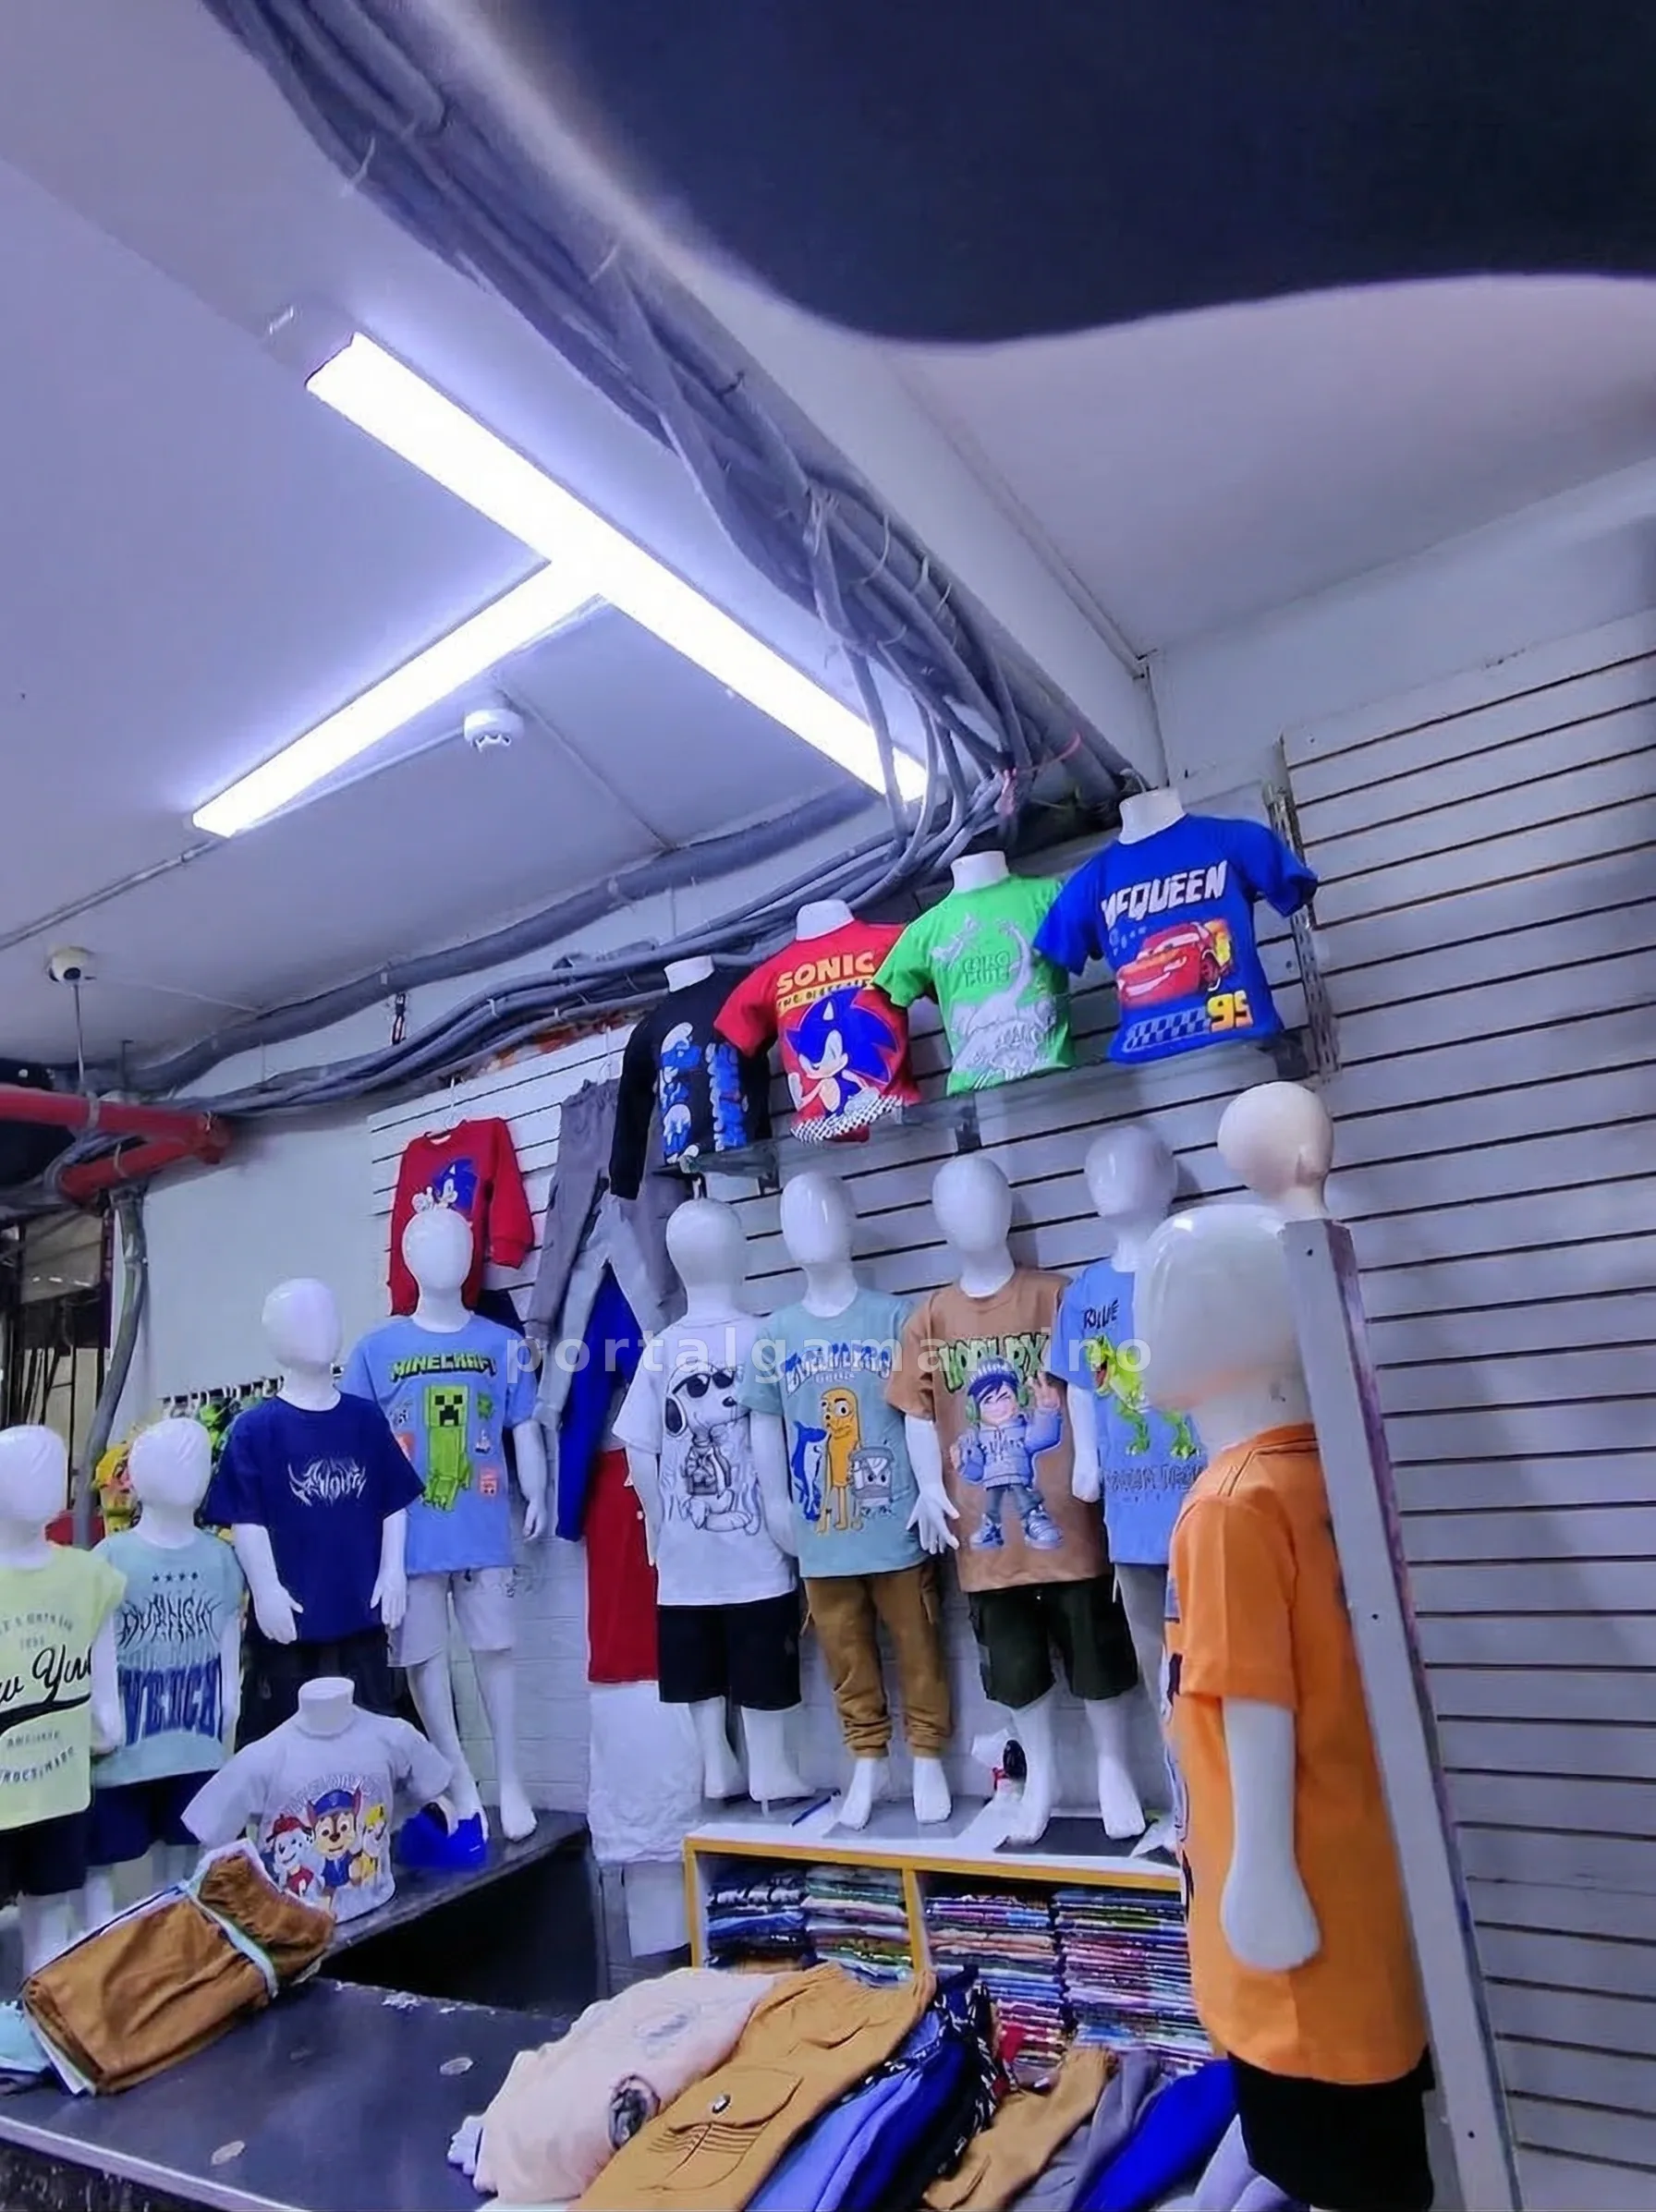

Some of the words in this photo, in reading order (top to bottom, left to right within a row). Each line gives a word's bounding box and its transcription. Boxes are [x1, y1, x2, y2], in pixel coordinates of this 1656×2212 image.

[776, 951, 876, 996] SONIC
[1207, 989, 1254, 1033] 95
[388, 1352, 498, 1383] MINECRAFT
